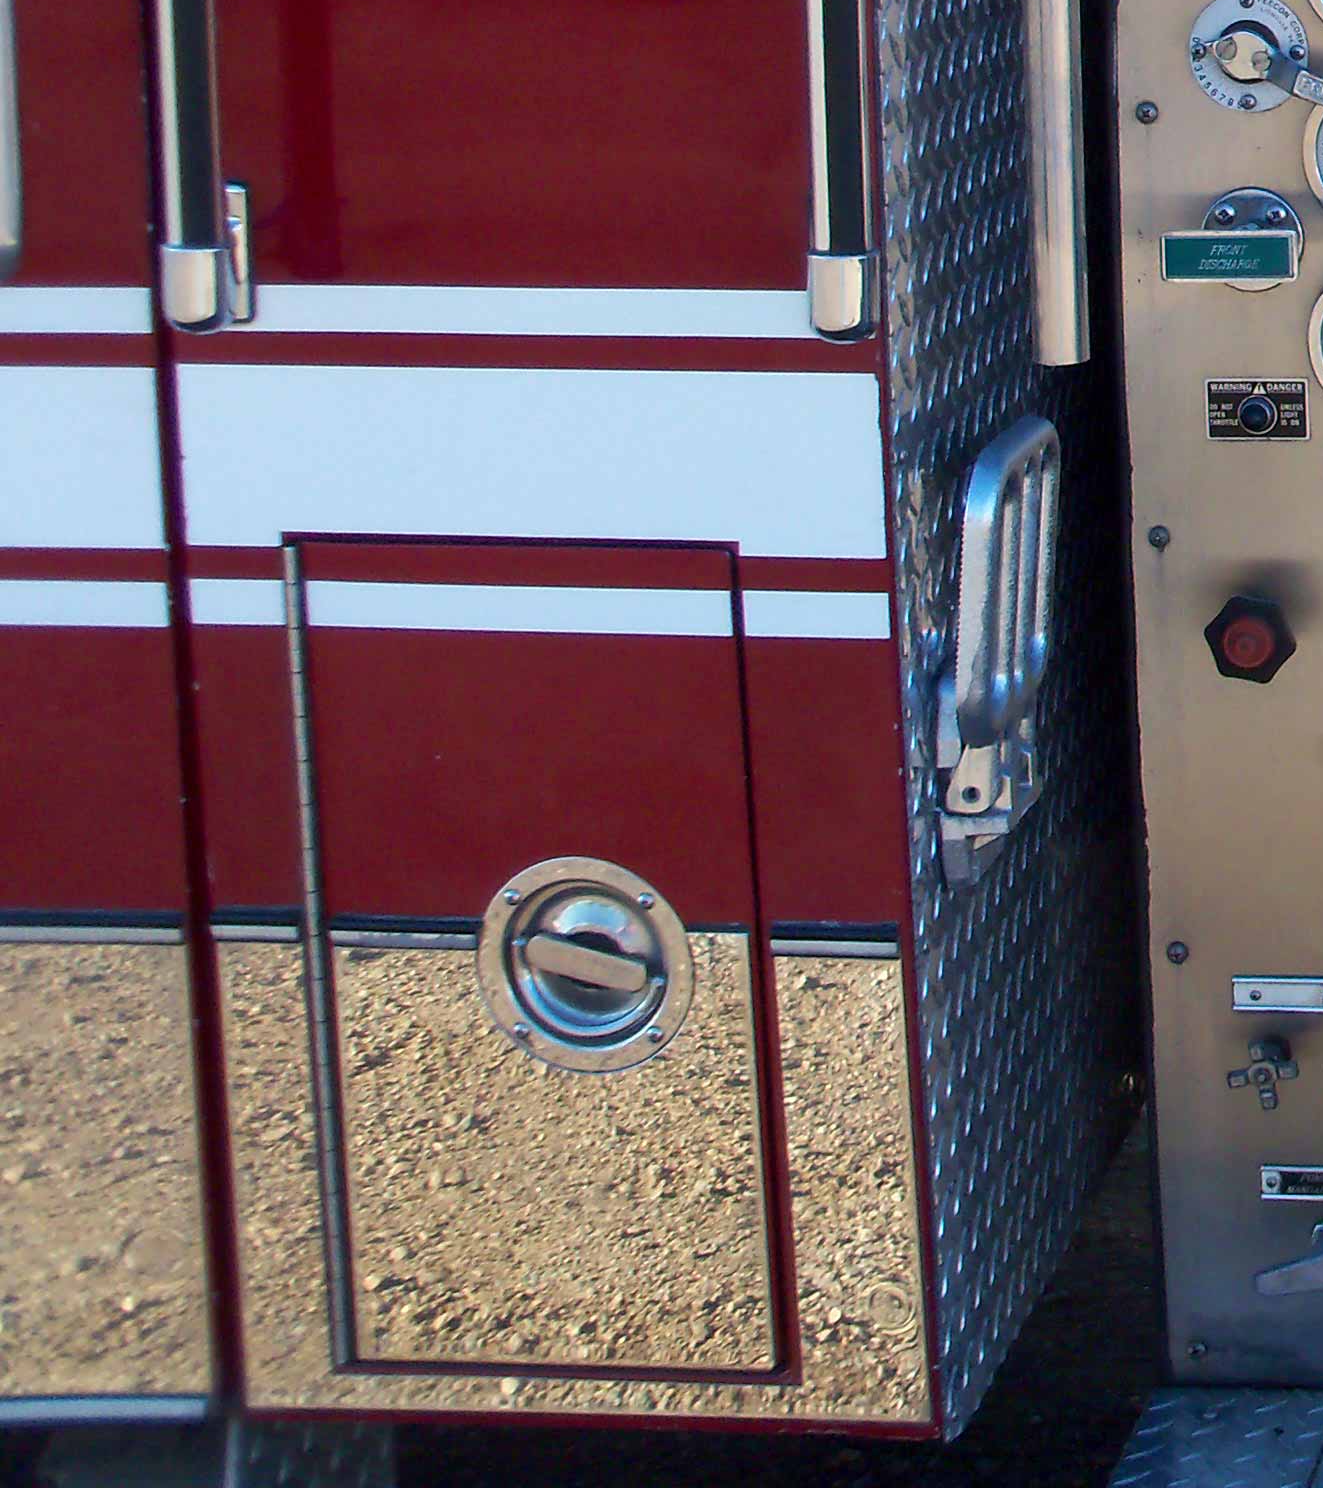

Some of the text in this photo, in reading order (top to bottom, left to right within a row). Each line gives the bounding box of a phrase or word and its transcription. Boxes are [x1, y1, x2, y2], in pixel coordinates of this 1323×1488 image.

[1209, 244, 1248, 256] FRONT
[1198, 258, 1260, 270] DISCHARGE
[1210, 383, 1303, 391] WARNING DANGER
